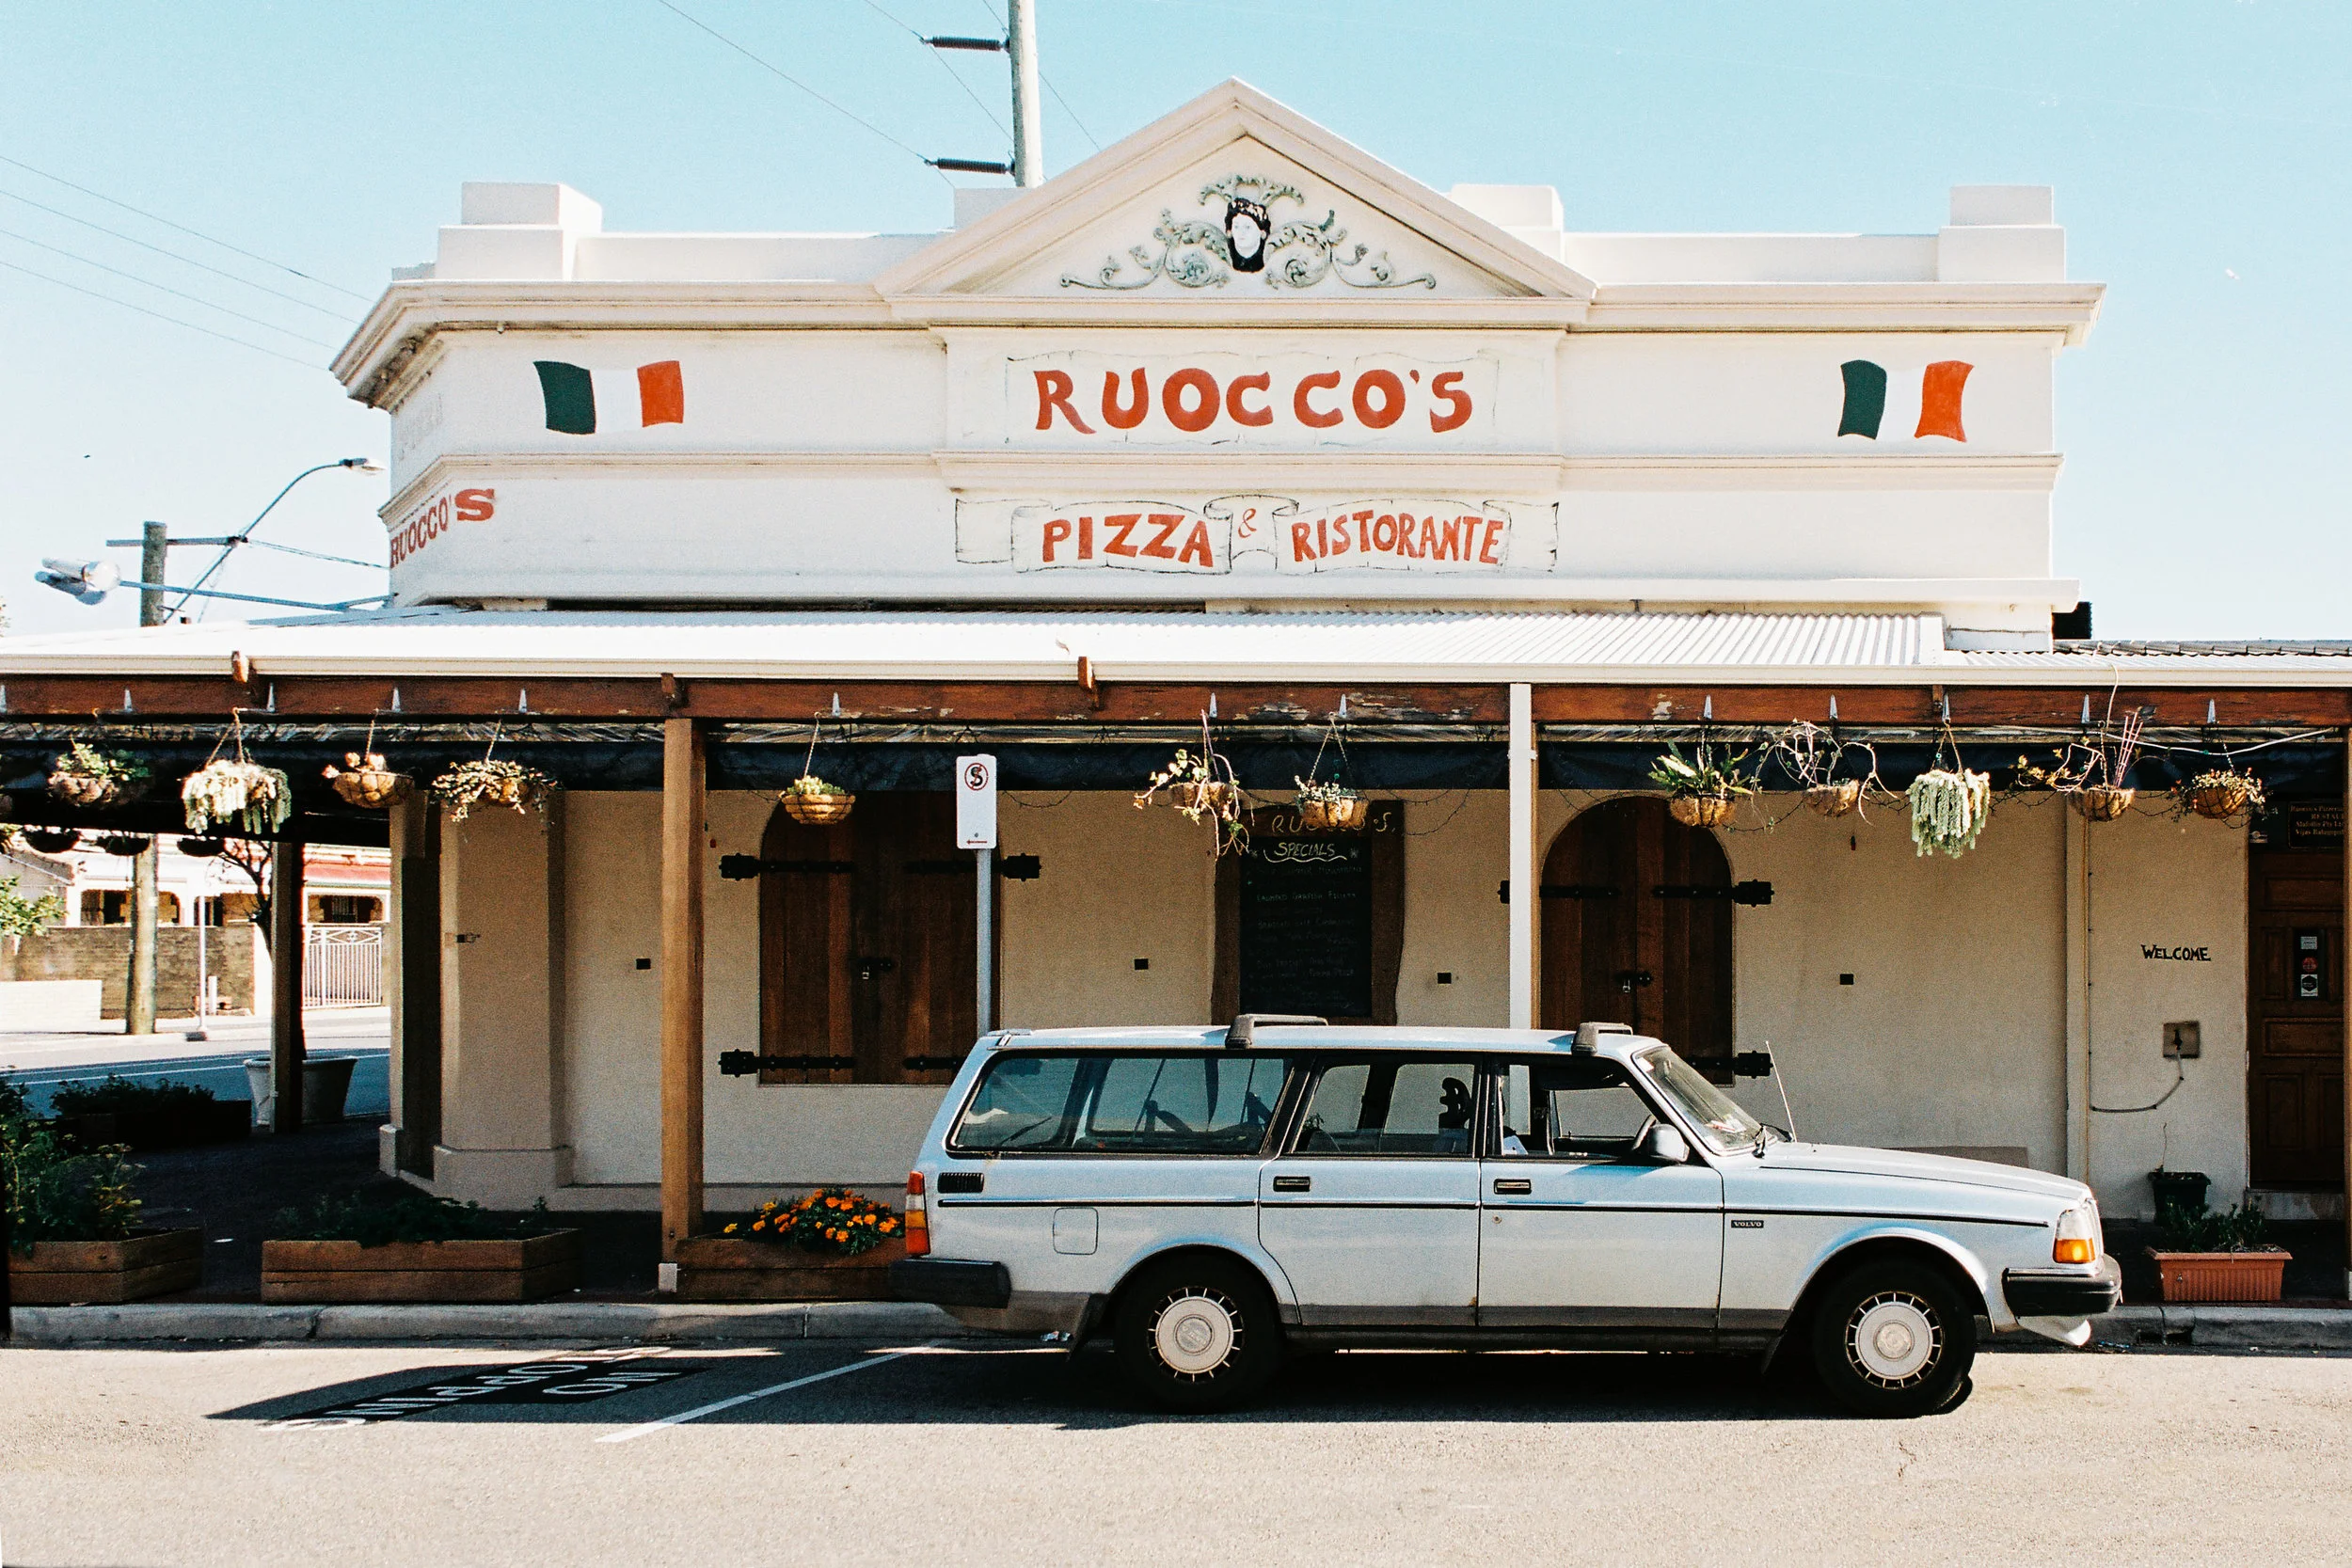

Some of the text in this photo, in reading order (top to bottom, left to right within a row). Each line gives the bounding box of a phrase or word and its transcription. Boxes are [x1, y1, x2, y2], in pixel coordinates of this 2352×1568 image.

[1034, 368, 1474, 436] RUOCCO'S
[389, 488, 496, 569] RUOCCO'S
[1042, 507, 1505, 569] PIZZA & RISTORANTE
[1273, 841, 1336, 857] SPECIALS
[2140, 943, 2212, 961] WELCOME
[542, 1371, 682, 1396] NO
